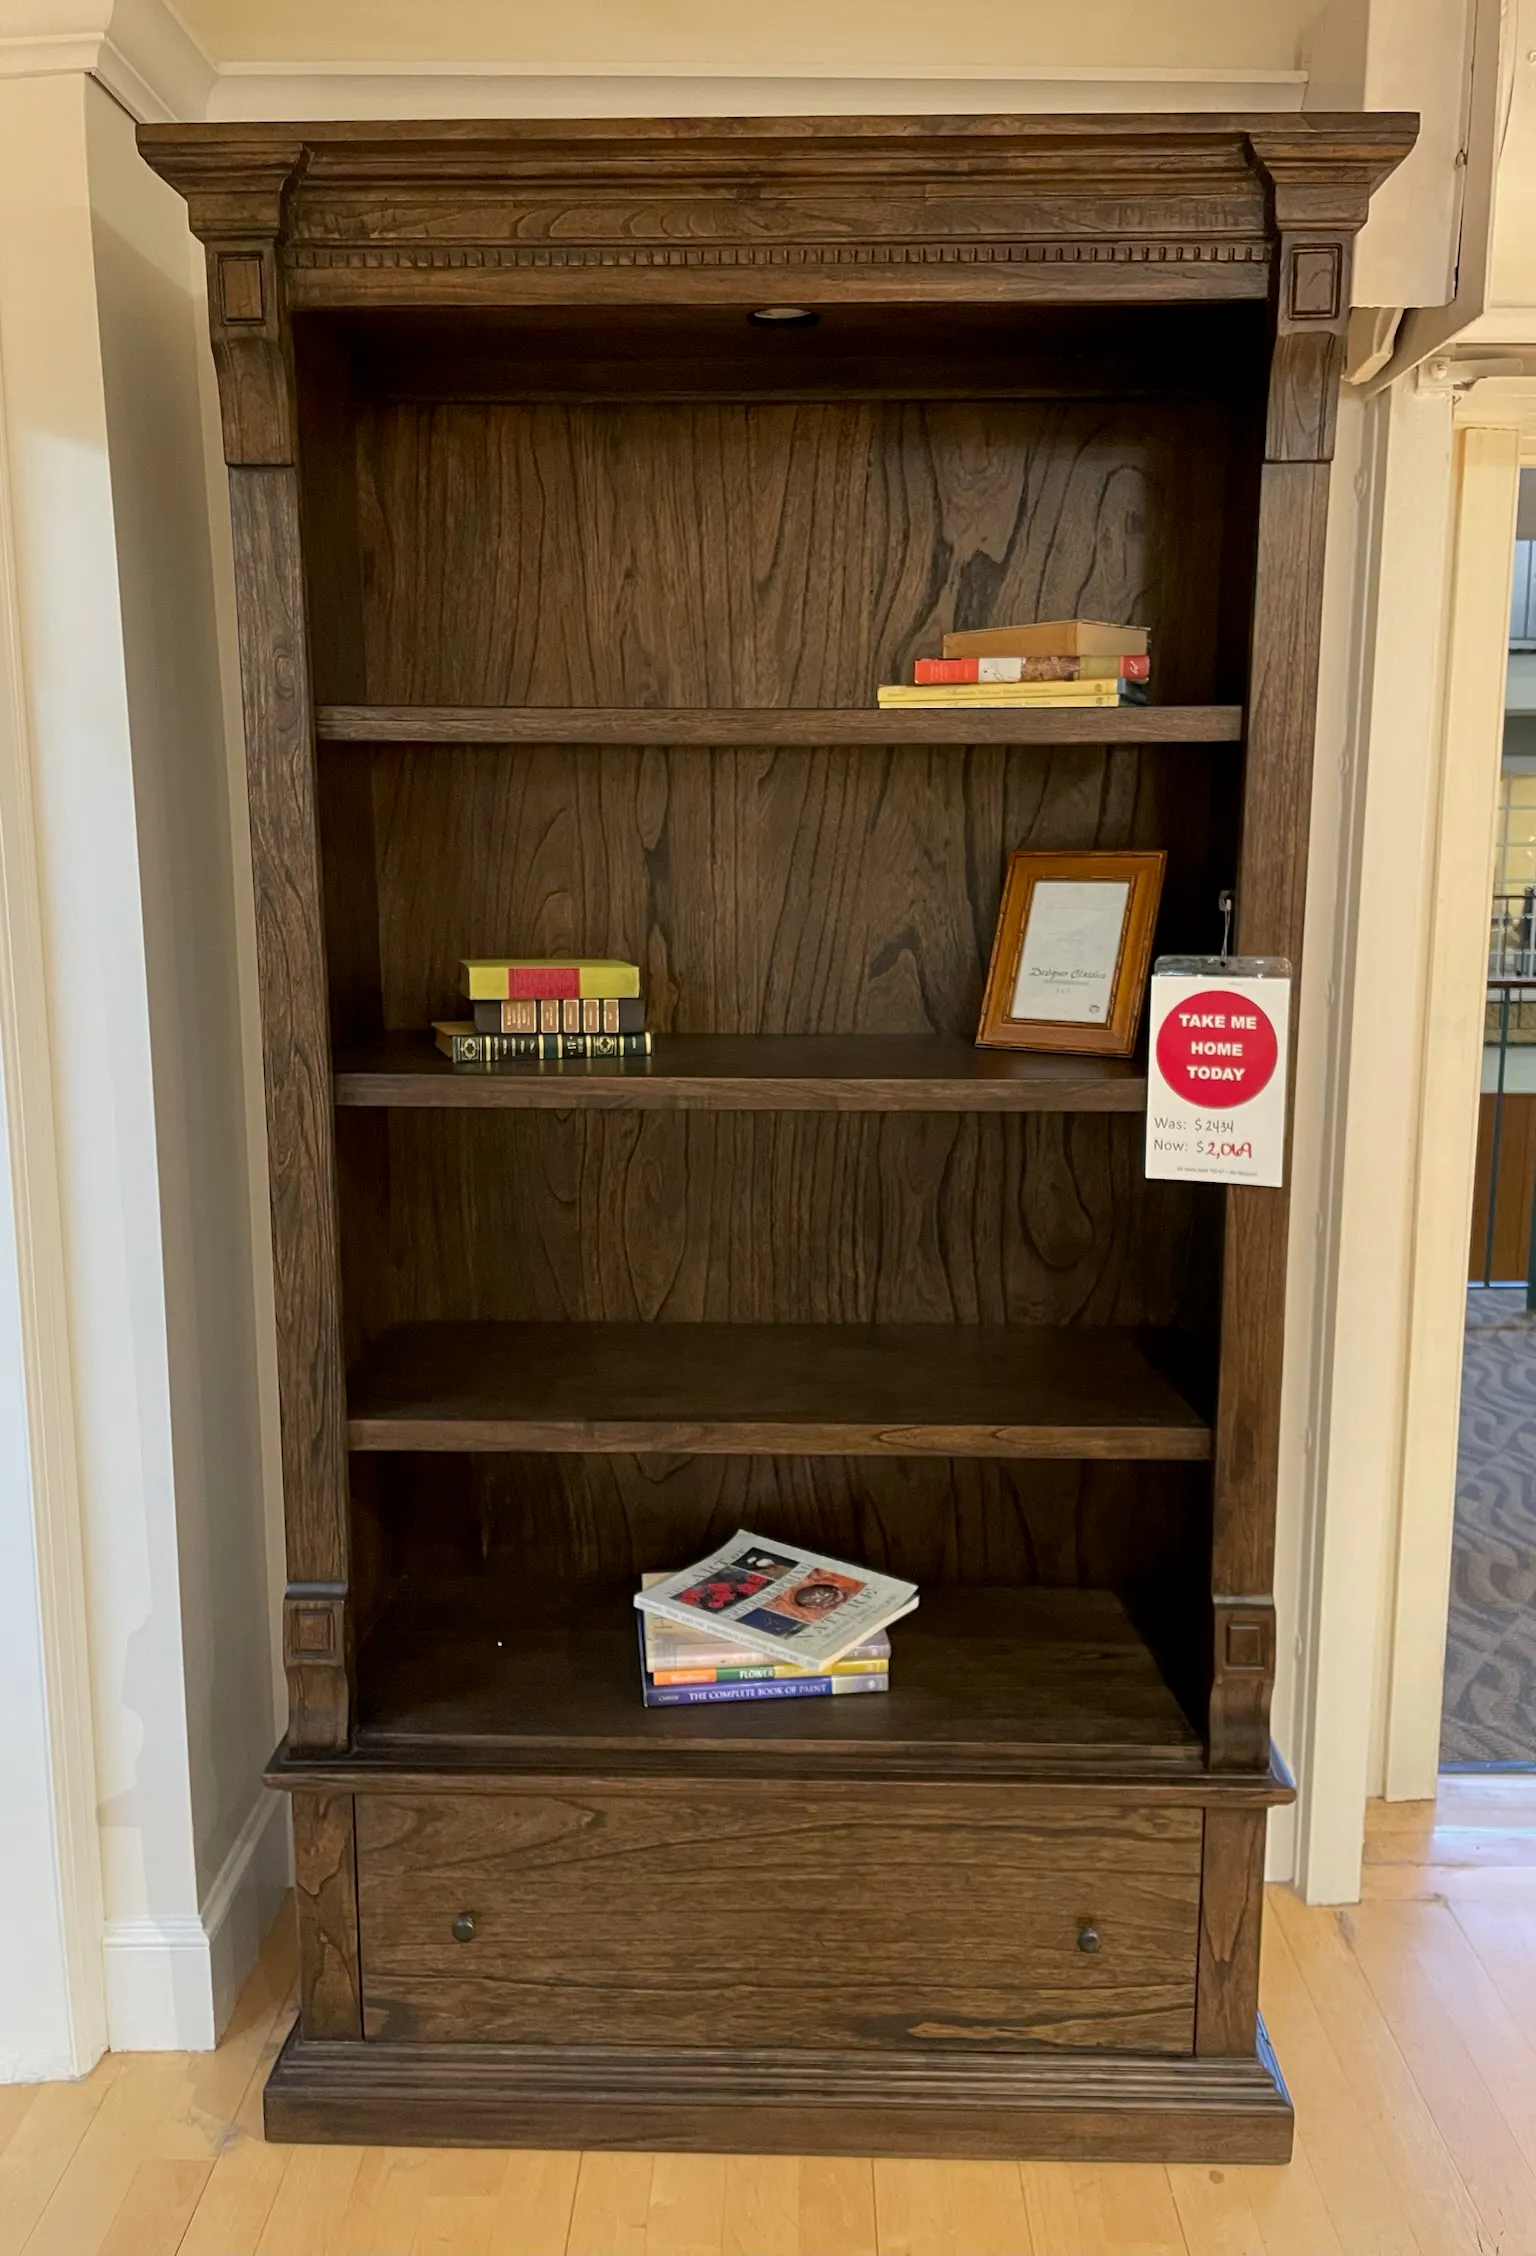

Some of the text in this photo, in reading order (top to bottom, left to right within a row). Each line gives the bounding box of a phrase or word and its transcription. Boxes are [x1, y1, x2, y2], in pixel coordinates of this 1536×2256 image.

[1178, 1013, 1257, 1030] TAKE ME
[1190, 1041, 1243, 1057] HOME
[1186, 1065, 1246, 1082] TODAY
[1154, 1117, 1187, 1130] Was:
[1153, 1138, 1188, 1152] Now:
[739, 1669, 774, 1680] FLOWER
[688, 1692, 707, 1701] THE
[708, 1688, 755, 1700] COMPLETE
[757, 1686, 783, 1697] BOOK
[784, 1685, 797, 1695] OF
[799, 1684, 827, 1694] PAINT
